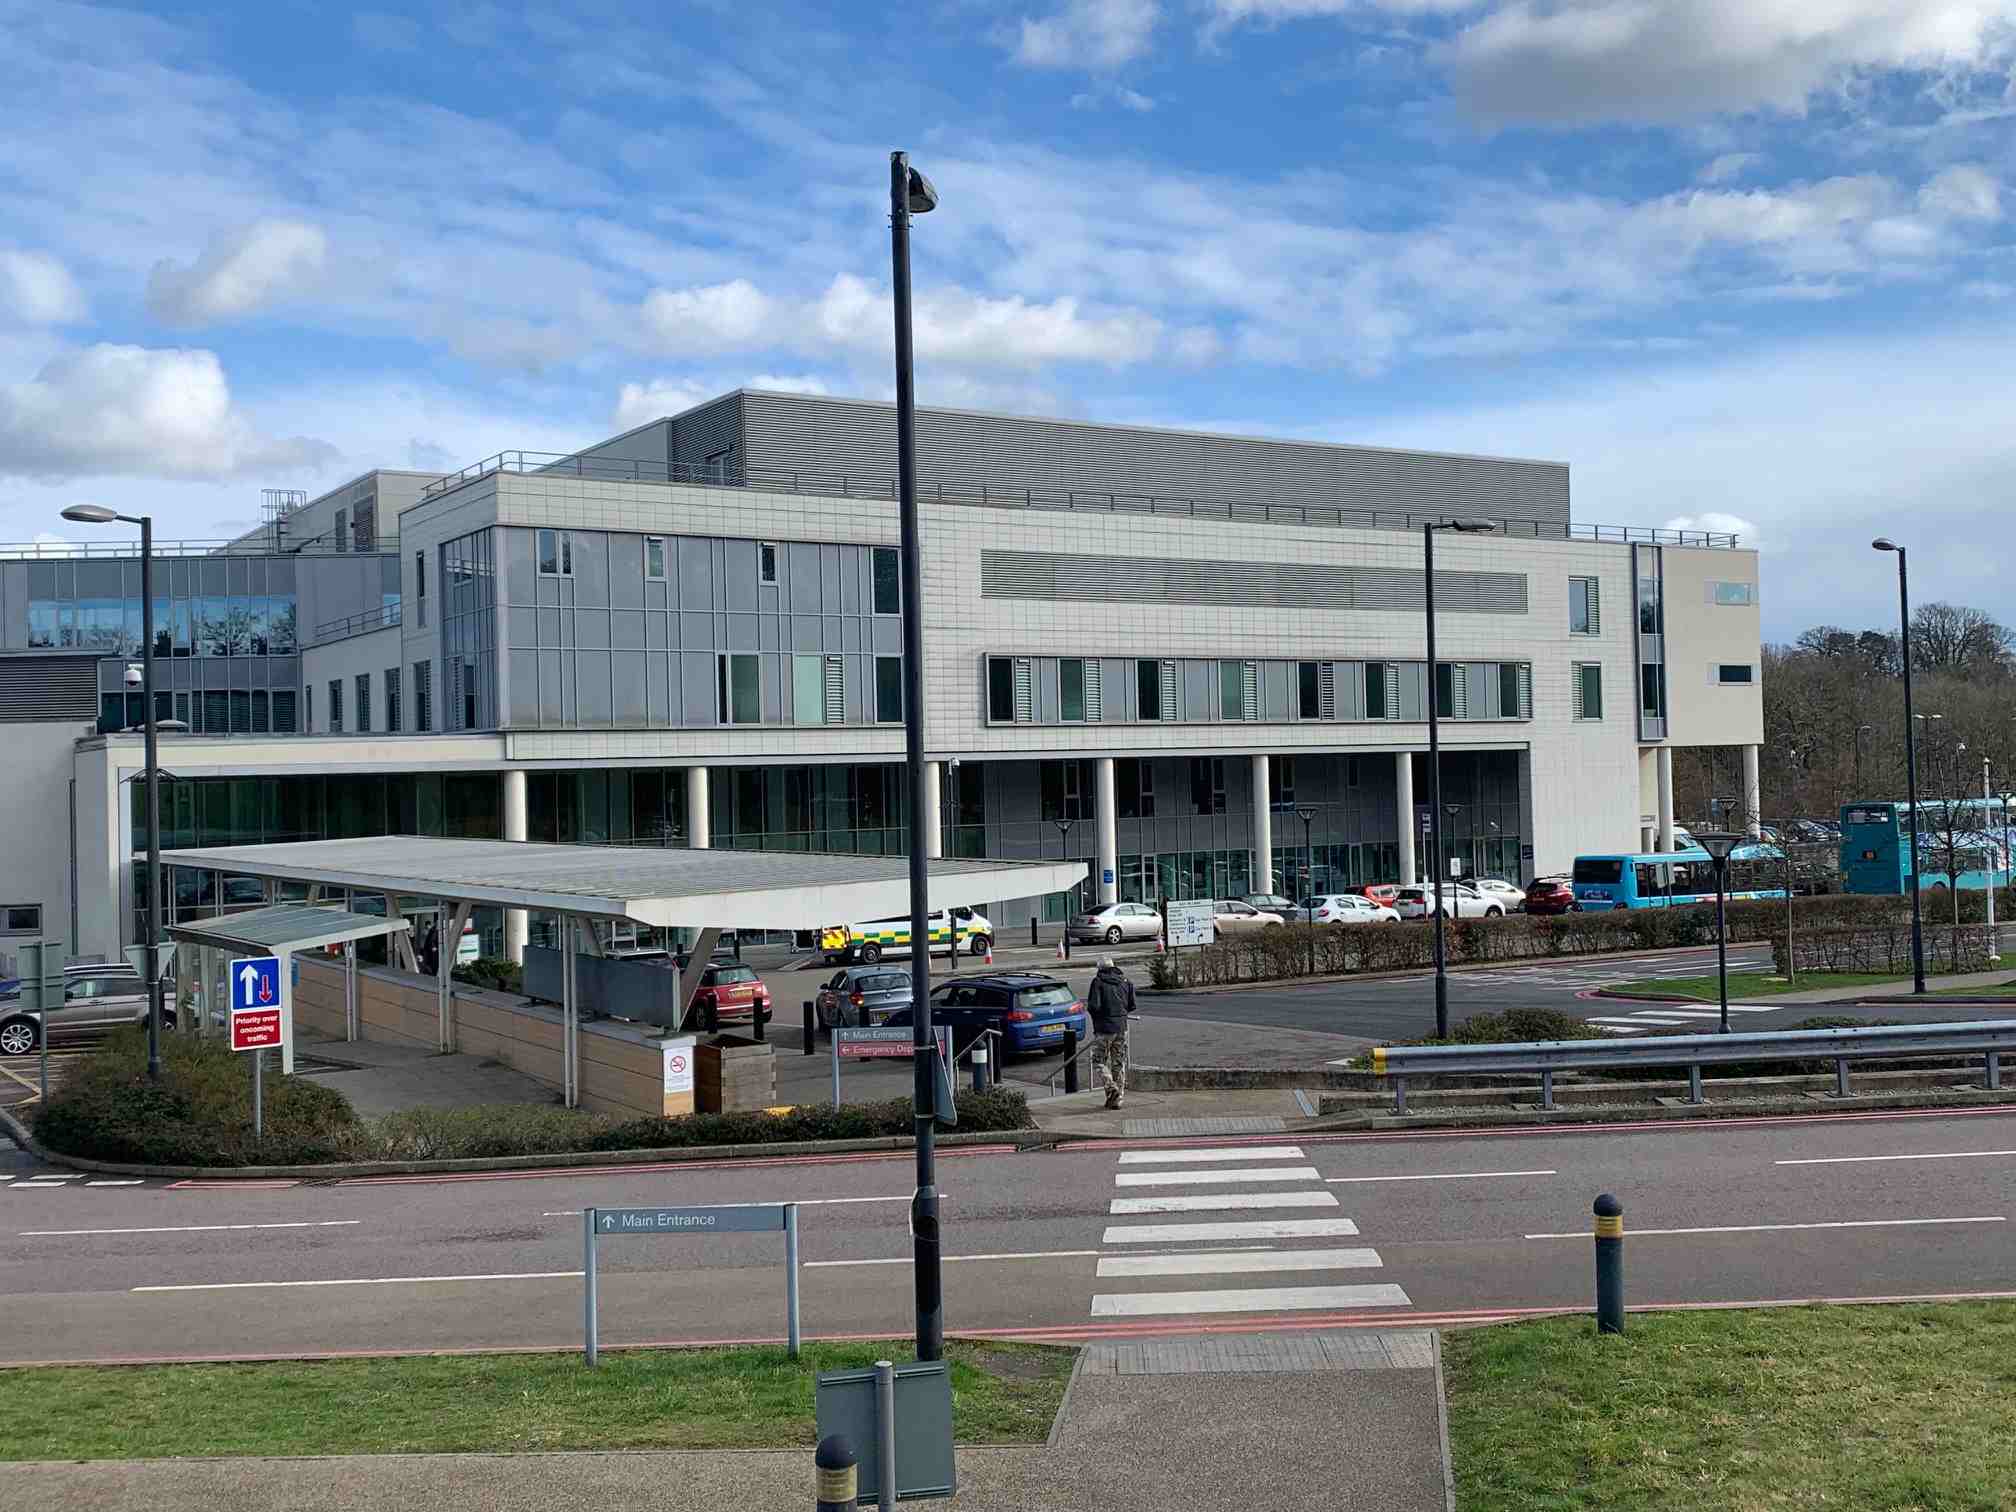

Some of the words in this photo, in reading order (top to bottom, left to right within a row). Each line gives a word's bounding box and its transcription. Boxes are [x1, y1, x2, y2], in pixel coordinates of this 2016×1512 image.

[235, 1016, 261, 1024] Priority
[240, 1025, 274, 1034] oncoming
[247, 1034, 268, 1042] traffic
[853, 1031, 871, 1040] Main
[872, 1030, 906, 1040] Entrance
[853, 1045, 896, 1056] Emergency
[622, 1214, 653, 1228] Main
[657, 1213, 716, 1227] Entrance
